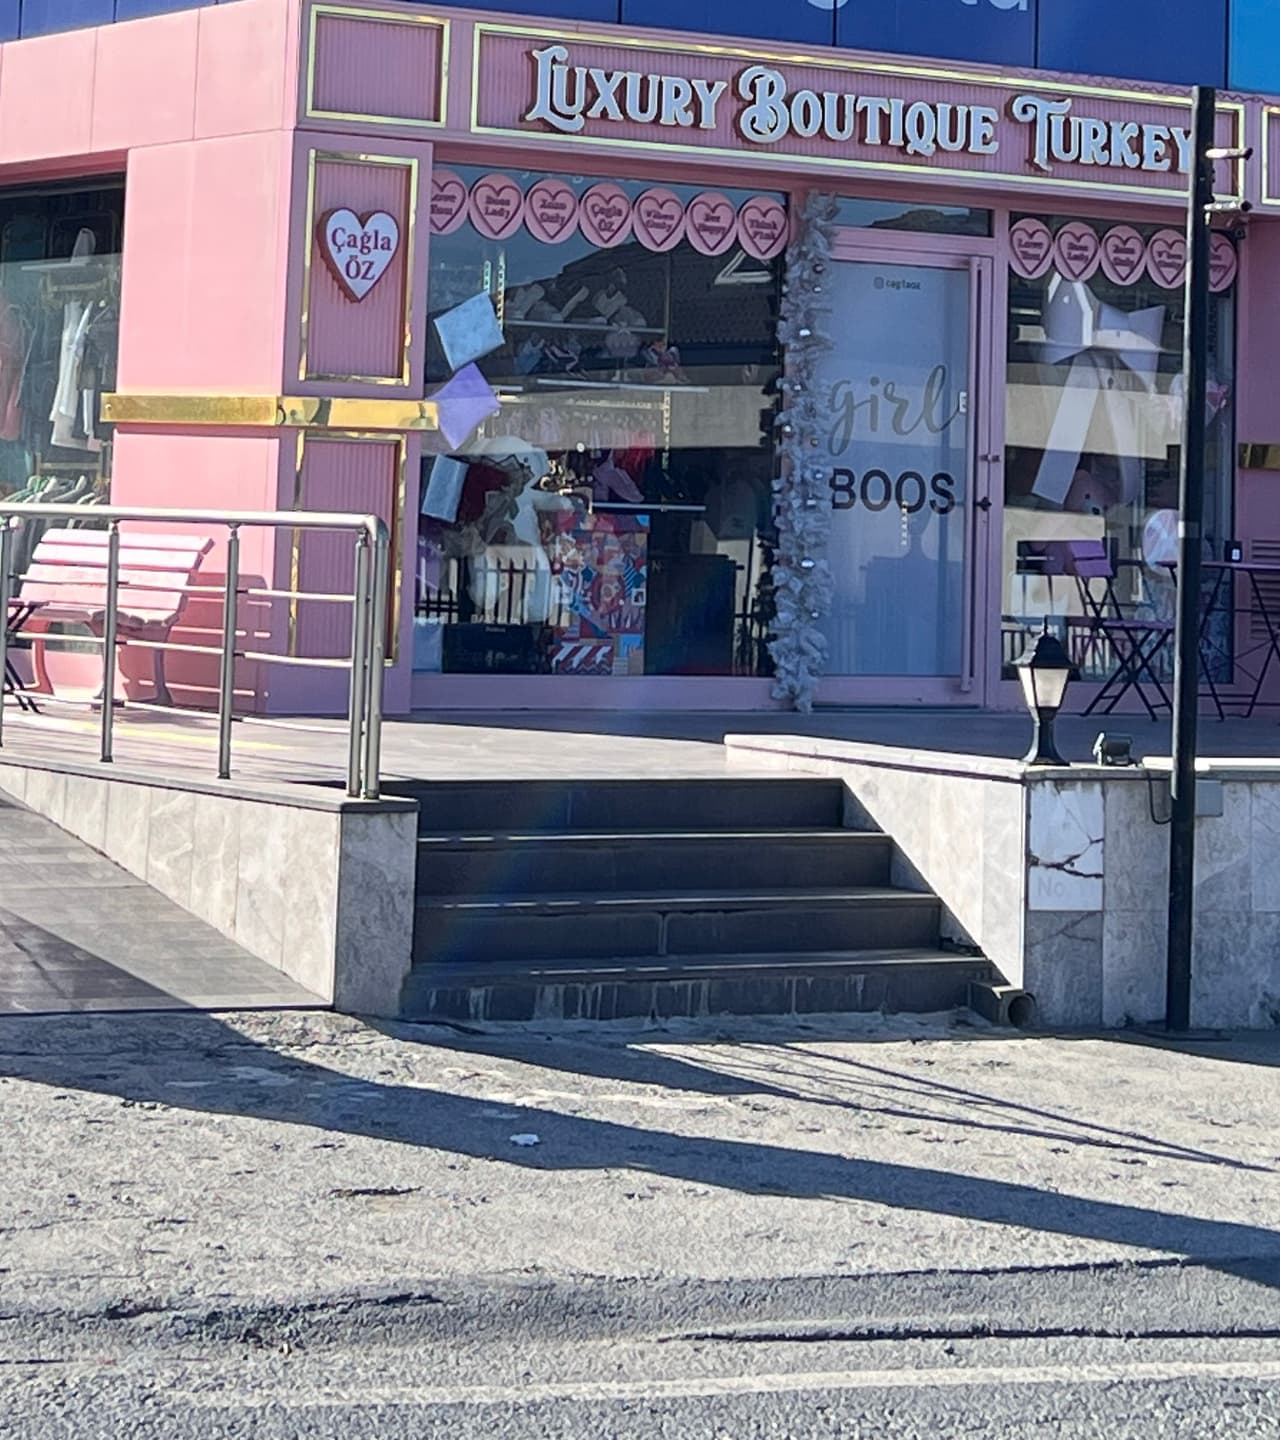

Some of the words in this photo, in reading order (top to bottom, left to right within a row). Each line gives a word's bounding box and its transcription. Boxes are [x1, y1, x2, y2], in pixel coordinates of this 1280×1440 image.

[523, 45, 728, 134] LUXURY
[738, 65, 998, 157] BOUTIQUE
[1012, 94, 1192, 174] TURKEY
[331, 226, 392, 255] Çağla
[345, 254, 375, 280] ÖZ
[828, 364, 960, 457] girl
[829, 467, 956, 515] BOOS
